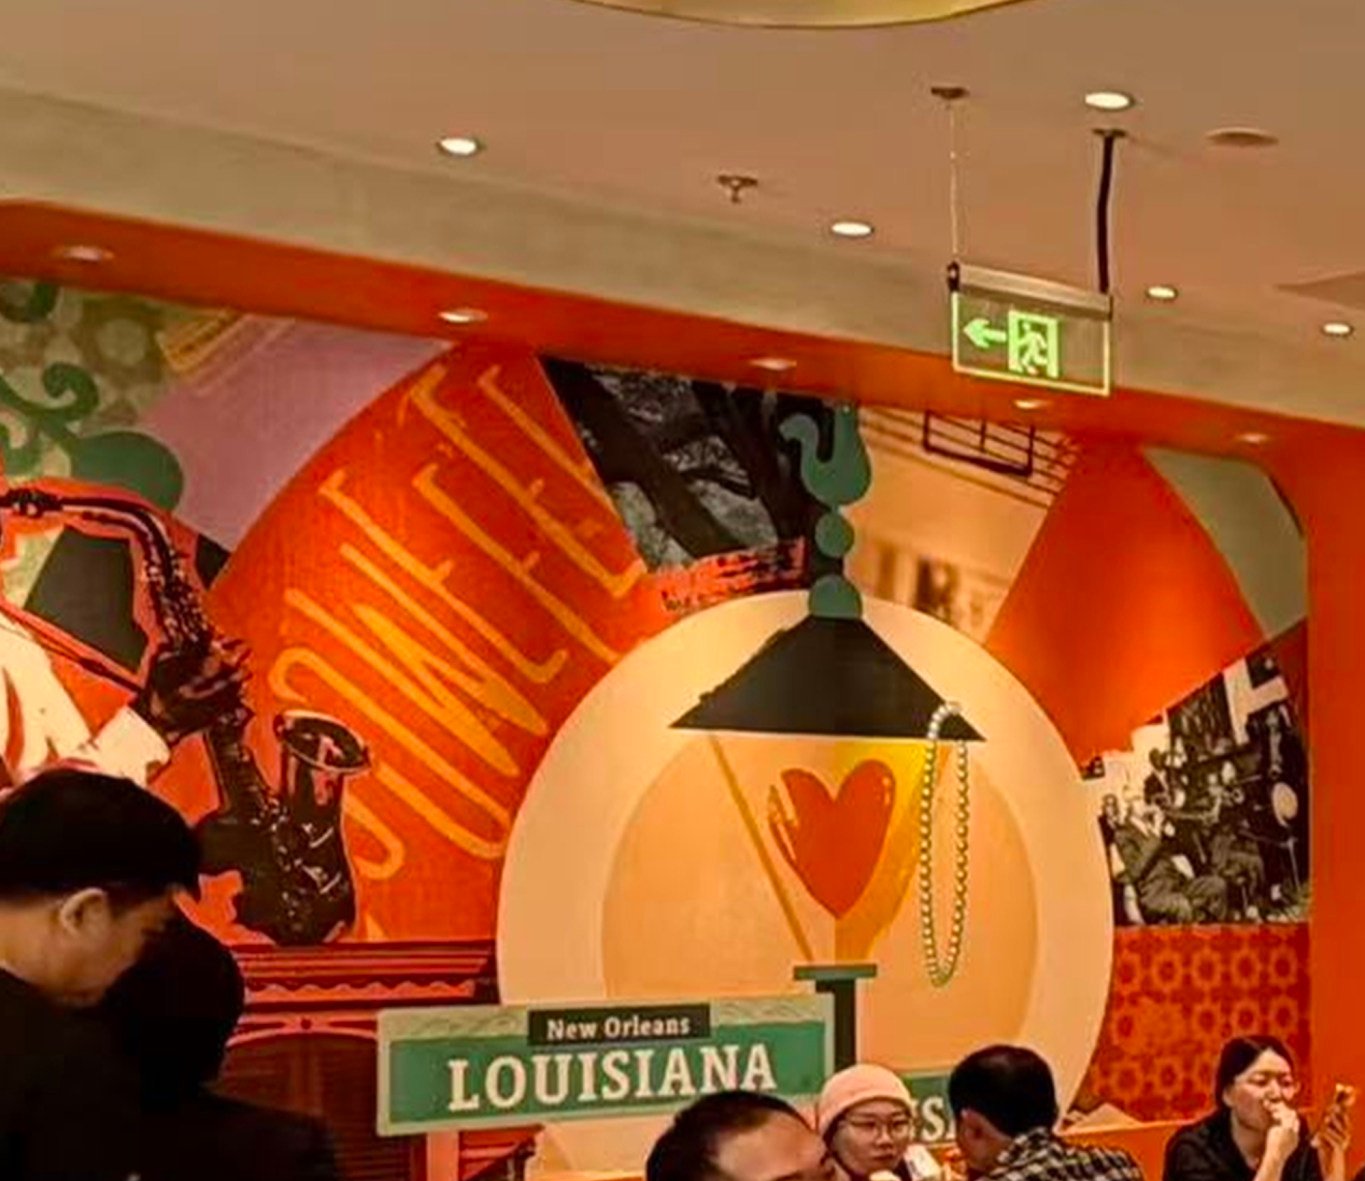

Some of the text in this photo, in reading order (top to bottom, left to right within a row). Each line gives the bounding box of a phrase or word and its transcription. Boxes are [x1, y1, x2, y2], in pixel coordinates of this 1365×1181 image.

[547, 1014, 691, 1041] New Orleans
[447, 1043, 777, 1112] LOUISIANA
